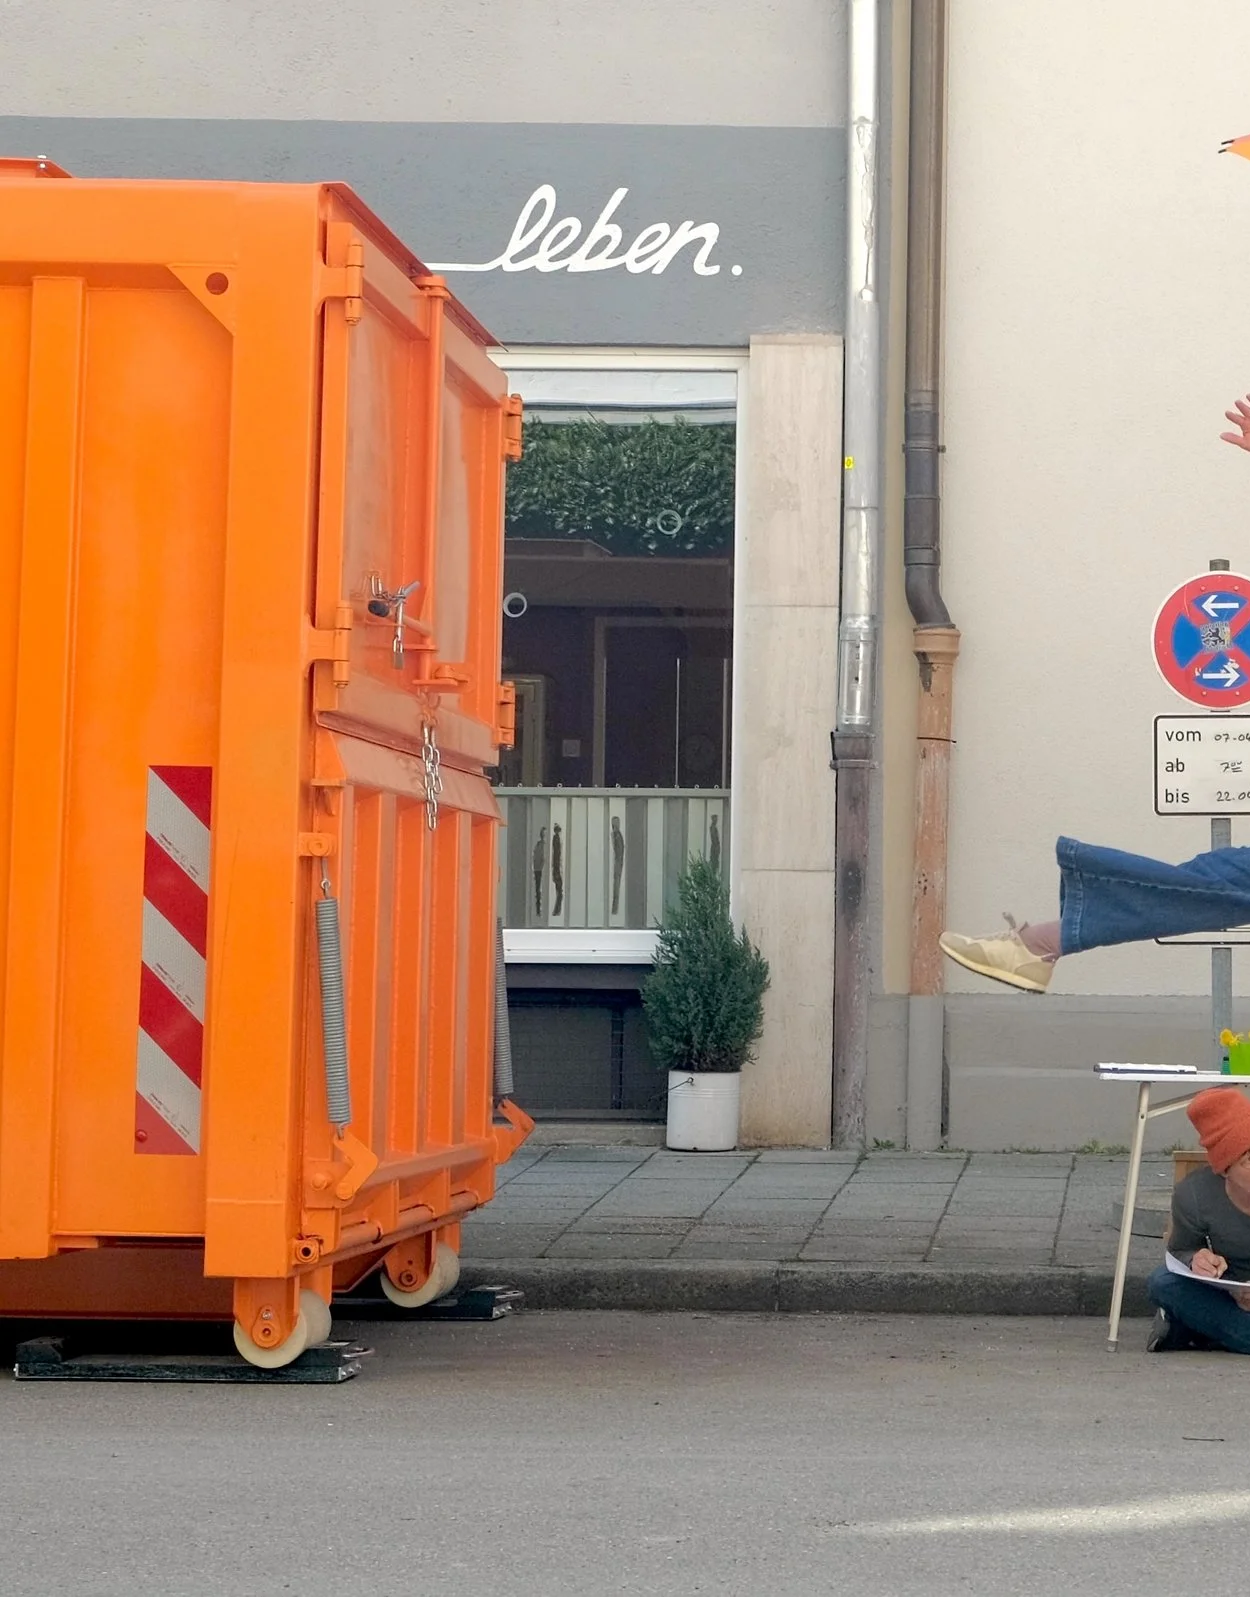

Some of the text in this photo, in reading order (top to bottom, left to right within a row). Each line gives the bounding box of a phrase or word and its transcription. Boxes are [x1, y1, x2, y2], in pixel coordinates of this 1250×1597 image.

[491, 184, 743, 276] leben.
[1165, 730, 1202, 742] vom
[1165, 758, 1185, 773] ab
[1165, 788, 1190, 803] bis
